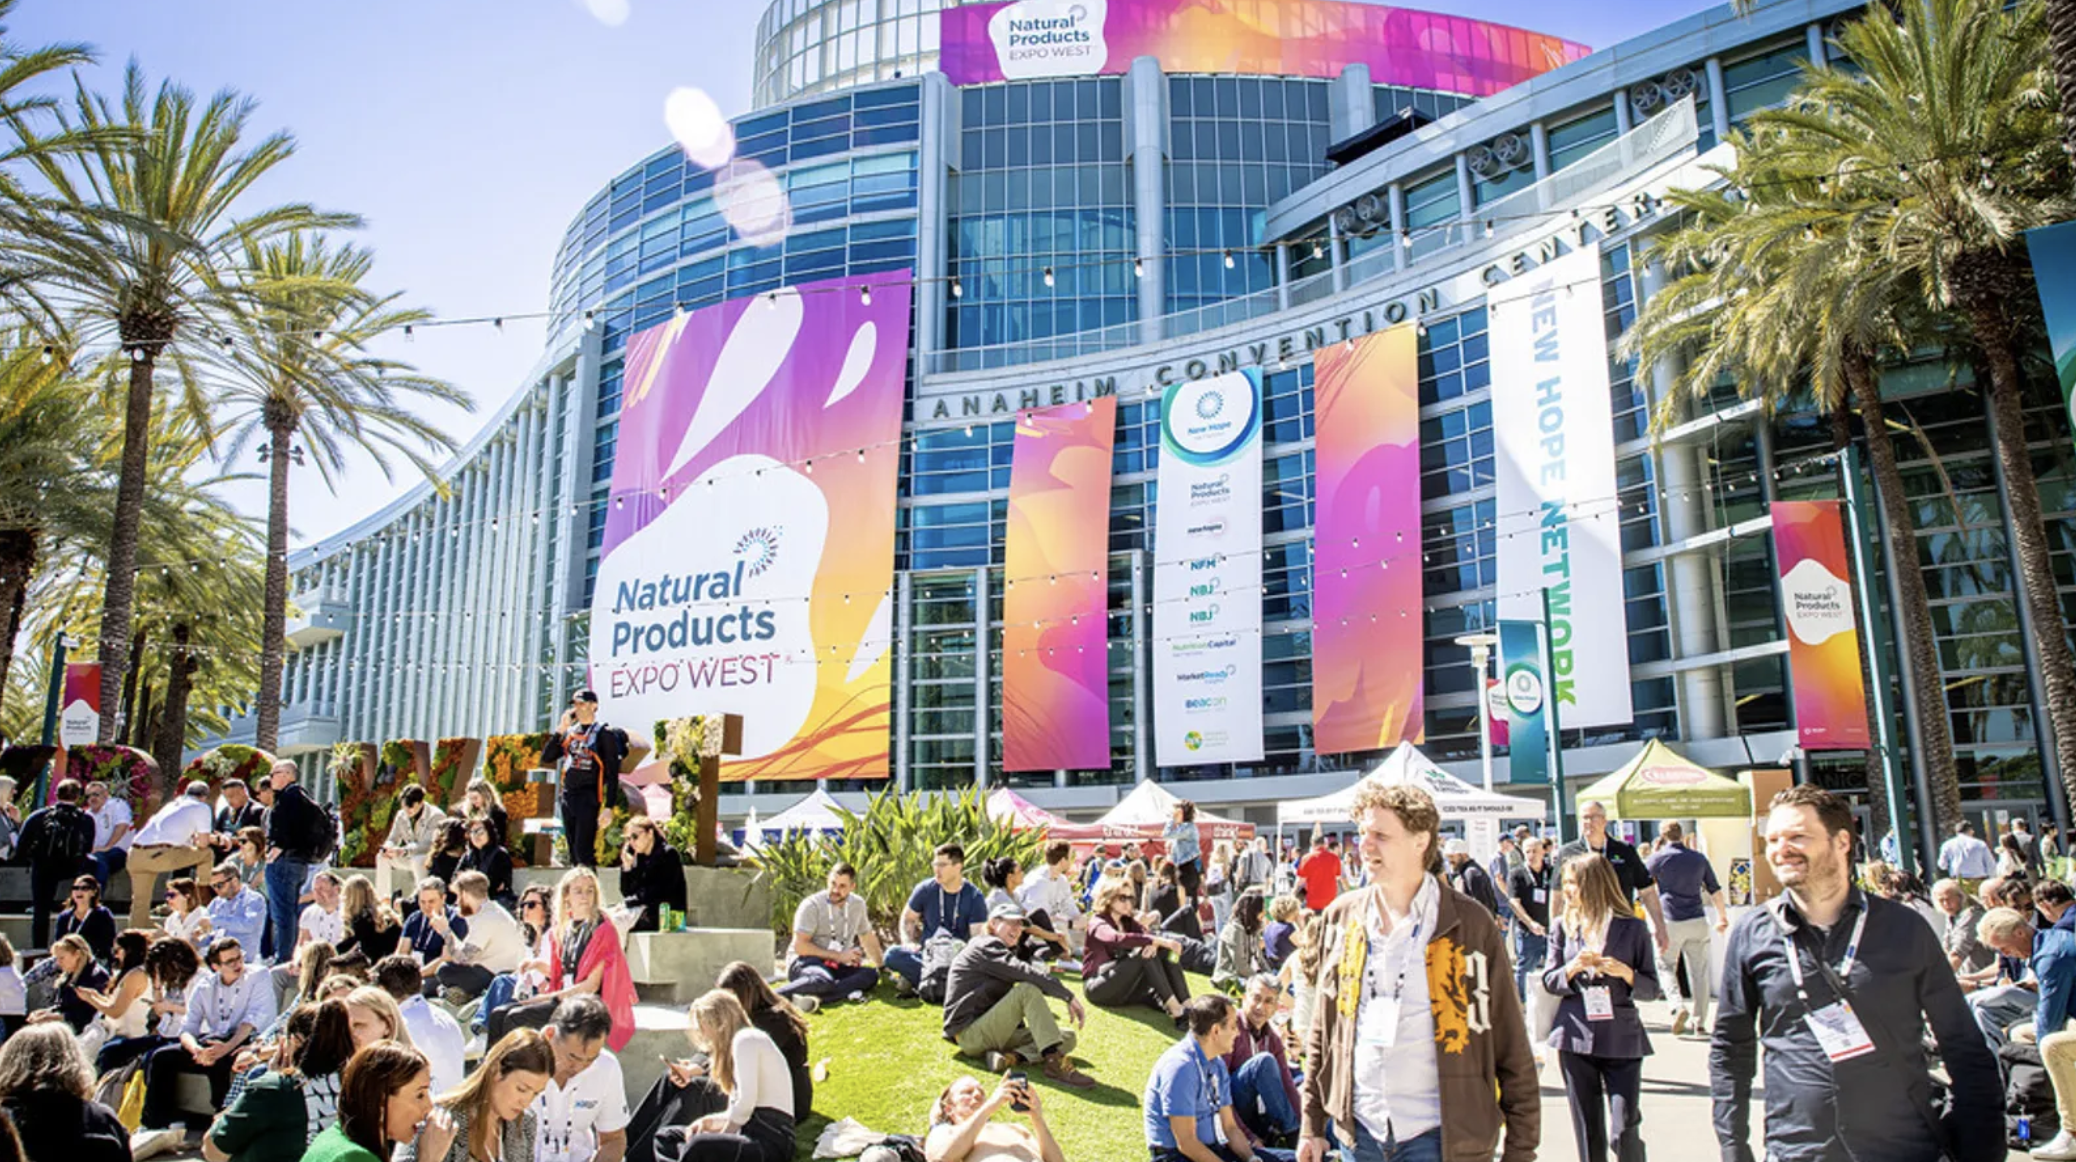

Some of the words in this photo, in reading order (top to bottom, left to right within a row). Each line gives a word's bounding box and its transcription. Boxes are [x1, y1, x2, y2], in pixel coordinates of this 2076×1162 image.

[1009, 14, 1075, 32] Natural
[1009, 30, 1090, 47] Products
[1009, 47, 1048, 60] EXPO
[1051, 45, 1091, 57] WEST
[933, 376, 1116, 418] ANAHEIM
[1154, 287, 1439, 387] CONVENTION
[1480, 191, 1651, 289] CENTER
[1530, 278, 1559, 363] NEW
[1536, 376, 1566, 486] HOPE
[1191, 487, 1231, 499] Products
[1191, 558, 1216, 571] NFM
[615, 560, 745, 614] Natural
[1191, 584, 1214, 597] NBJ
[1794, 591, 1832, 600] Natural
[1796, 601, 1840, 610] Products
[1191, 610, 1213, 622] NBJ
[612, 605, 776, 657] Products
[611, 663, 679, 698] EXPO
[688, 654, 781, 689] WEST
